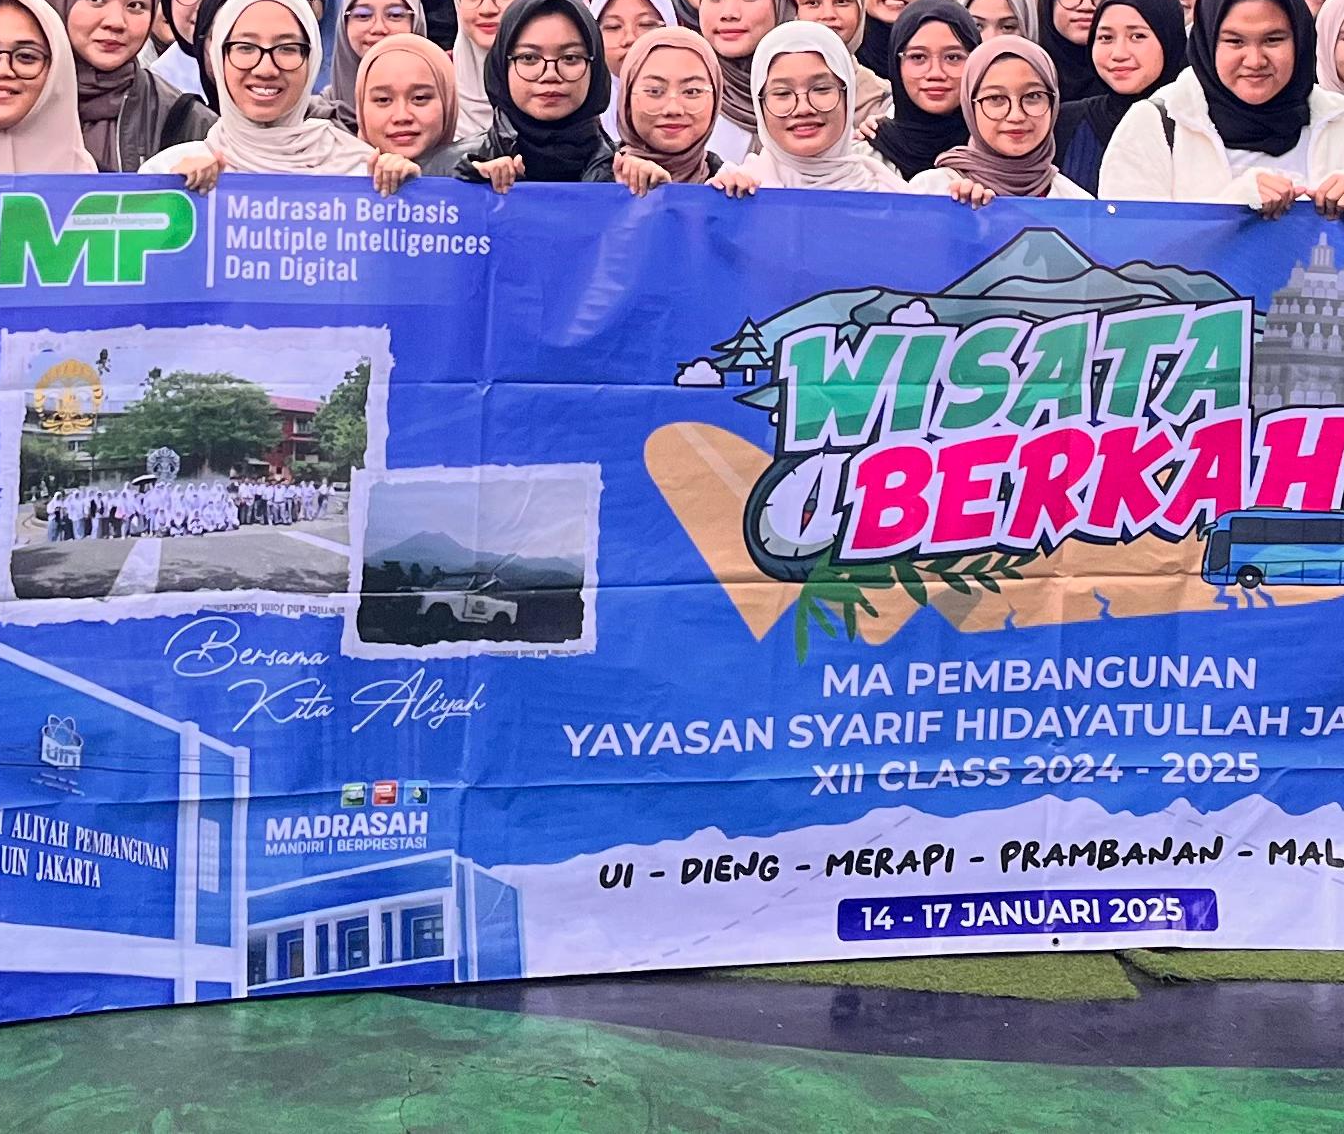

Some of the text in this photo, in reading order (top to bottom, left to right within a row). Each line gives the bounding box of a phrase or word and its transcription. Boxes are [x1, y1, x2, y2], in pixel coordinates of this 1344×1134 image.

[227, 195, 459, 224] Madrasah Berbasis
[226, 225, 491, 257] Multiple Intelligences
[225, 255, 358, 286] Dan Digital
[784, 303, 1253, 446] WISATA
[164, 616, 329, 677] Bersama
[822, 655, 1256, 697] MA PEMBANGUNAN
[228, 667, 486, 732] Kita Aliyah
[563, 717, 774, 757] YAYASAN
[788, 710, 943, 748] SYARIF
[956, 703, 1289, 741] HIDAYATULLAH
[810, 763, 862, 796] XII
[879, 756, 1012, 792] CLASS
[1021, 752, 1123, 786] 2024
[1161, 752, 1260, 785] 2025
[11, 811, 68, 848] ALIYAH
[75, 826, 169, 871] PEMBANGUNAN
[265, 811, 429, 841] MADRASAH
[265, 841, 324, 856] MANDIRI
[337, 837, 427, 852] BERPRESTASI
[1, 845, 101, 888] UIN JAKARTA
[599, 863, 634, 889] UI
[681, 851, 780, 884] DIENG
[825, 844, 954, 878] MERAPI
[1000, 836, 1223, 874] PRAMBANAN
[861, 905, 894, 930] 14
[921, 904, 953, 928] 17
[960, 898, 1100, 928] JANUARI
[1108, 897, 1183, 924] 2025
